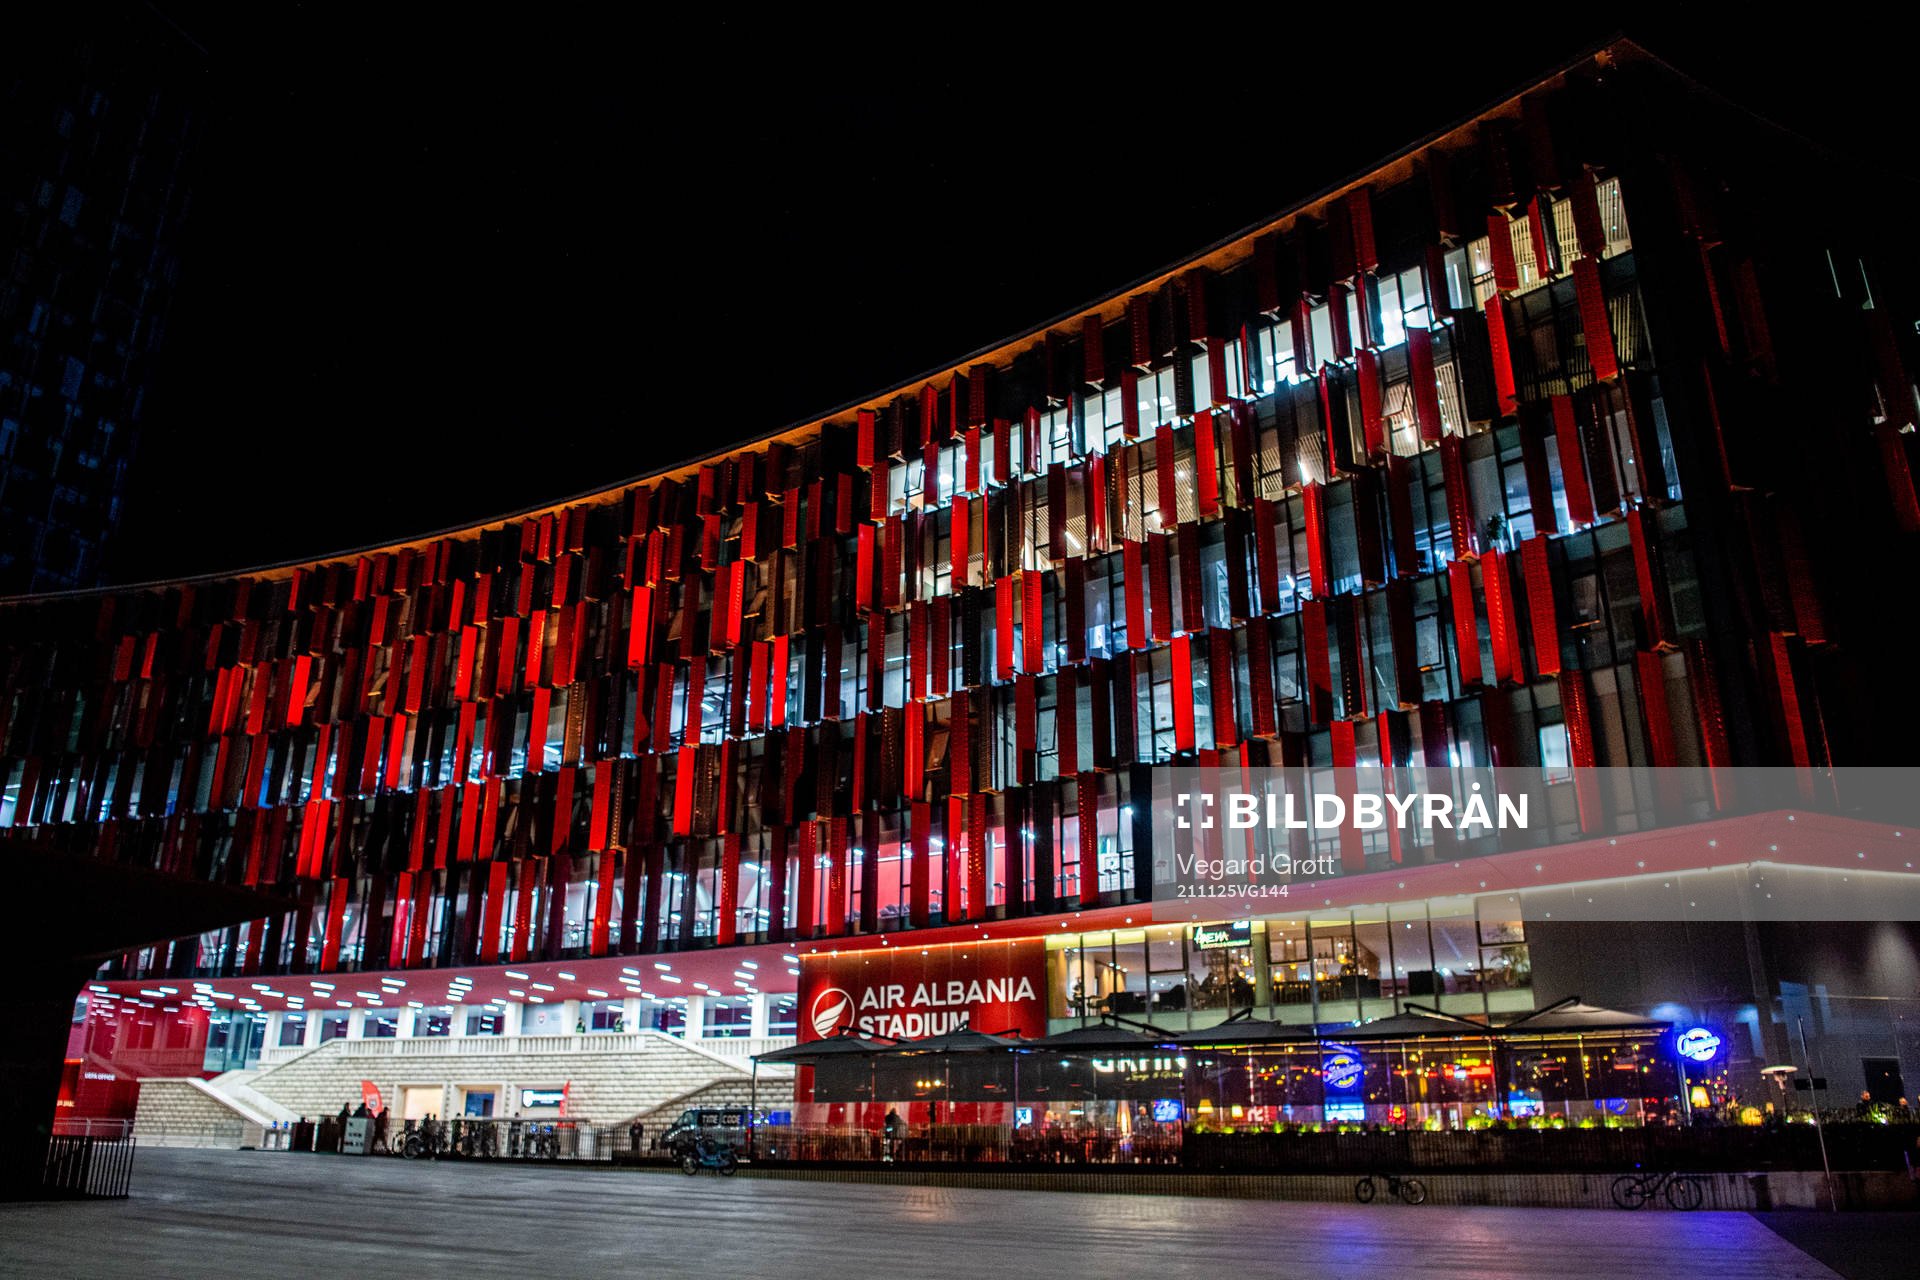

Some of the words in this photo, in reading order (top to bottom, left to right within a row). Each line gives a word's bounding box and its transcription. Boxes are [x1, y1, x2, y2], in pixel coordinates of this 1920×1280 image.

[860, 986, 905, 1010] AIR
[911, 976, 1036, 1007] ALBANIA
[858, 1010, 969, 1040] STADIUM
[702, 1115, 718, 1124] TIME
